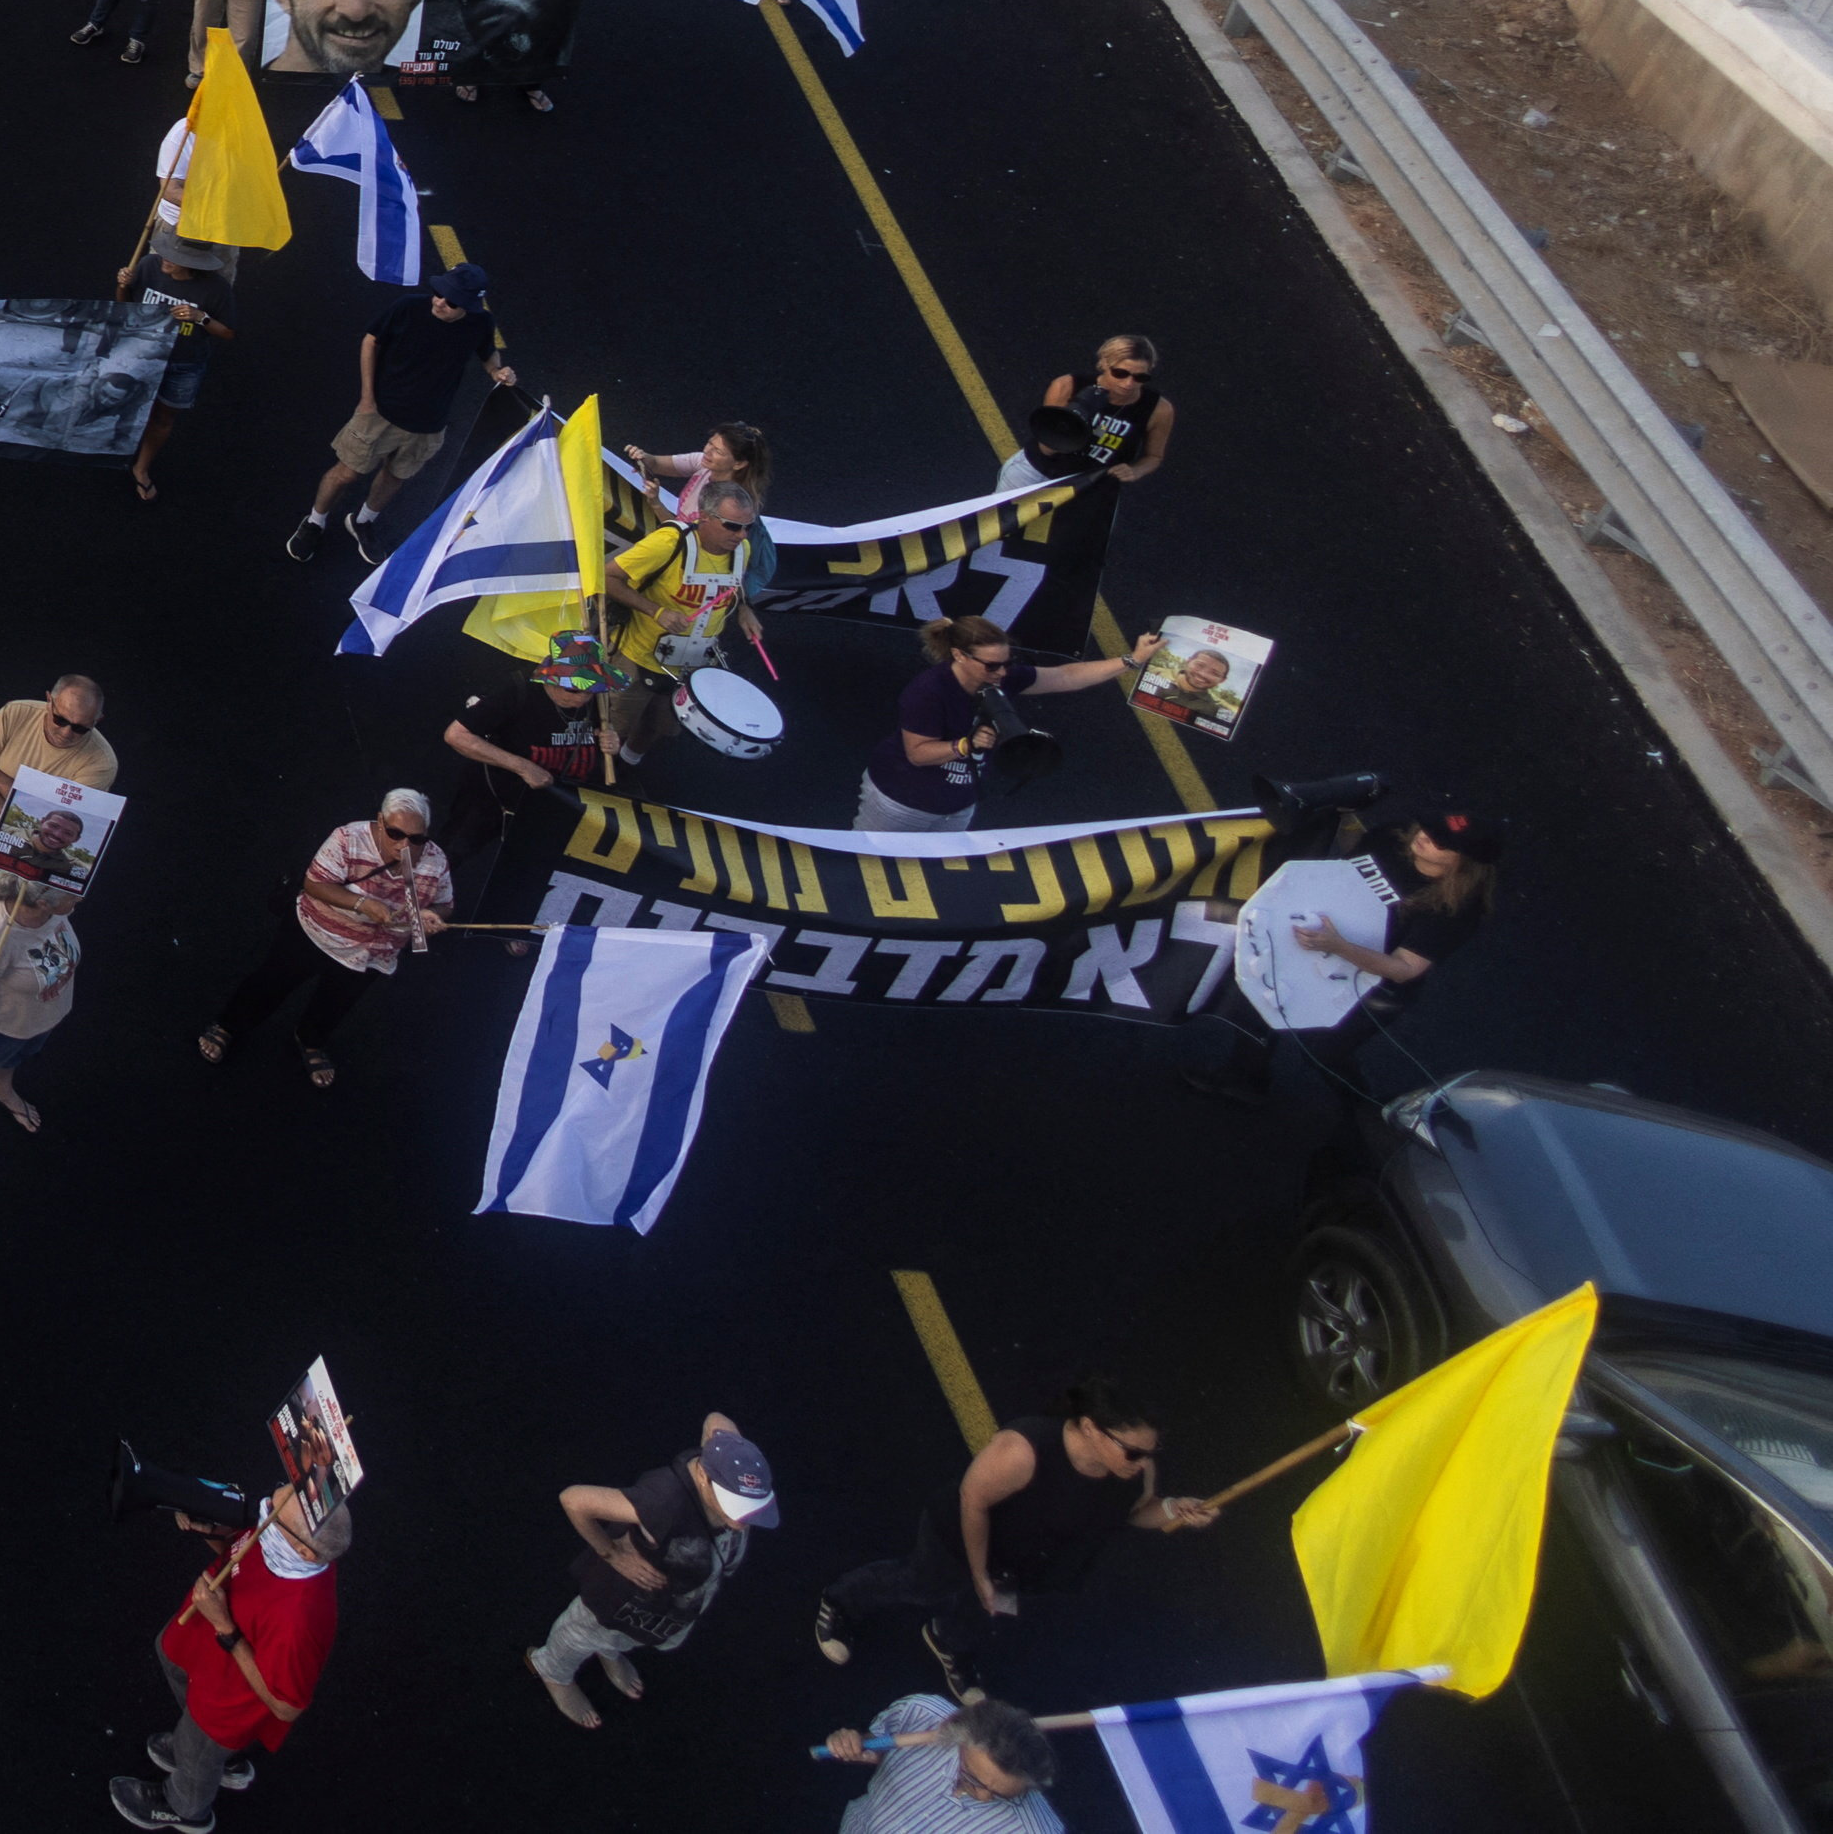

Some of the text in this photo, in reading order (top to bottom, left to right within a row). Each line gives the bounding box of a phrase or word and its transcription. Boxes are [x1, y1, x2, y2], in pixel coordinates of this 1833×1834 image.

[432, 39, 461, 52] לעולם
[417, 51, 446, 62] לא עוד
[402, 62, 450, 73] זה עכשיו!
[869, 541, 1046, 631] לא
[1141, 671, 1172, 690] BRING
[1137, 680, 1158, 696] HIM
[1063, 900, 1243, 1014] לא
[150, 1809, 182, 1822] HOKA
